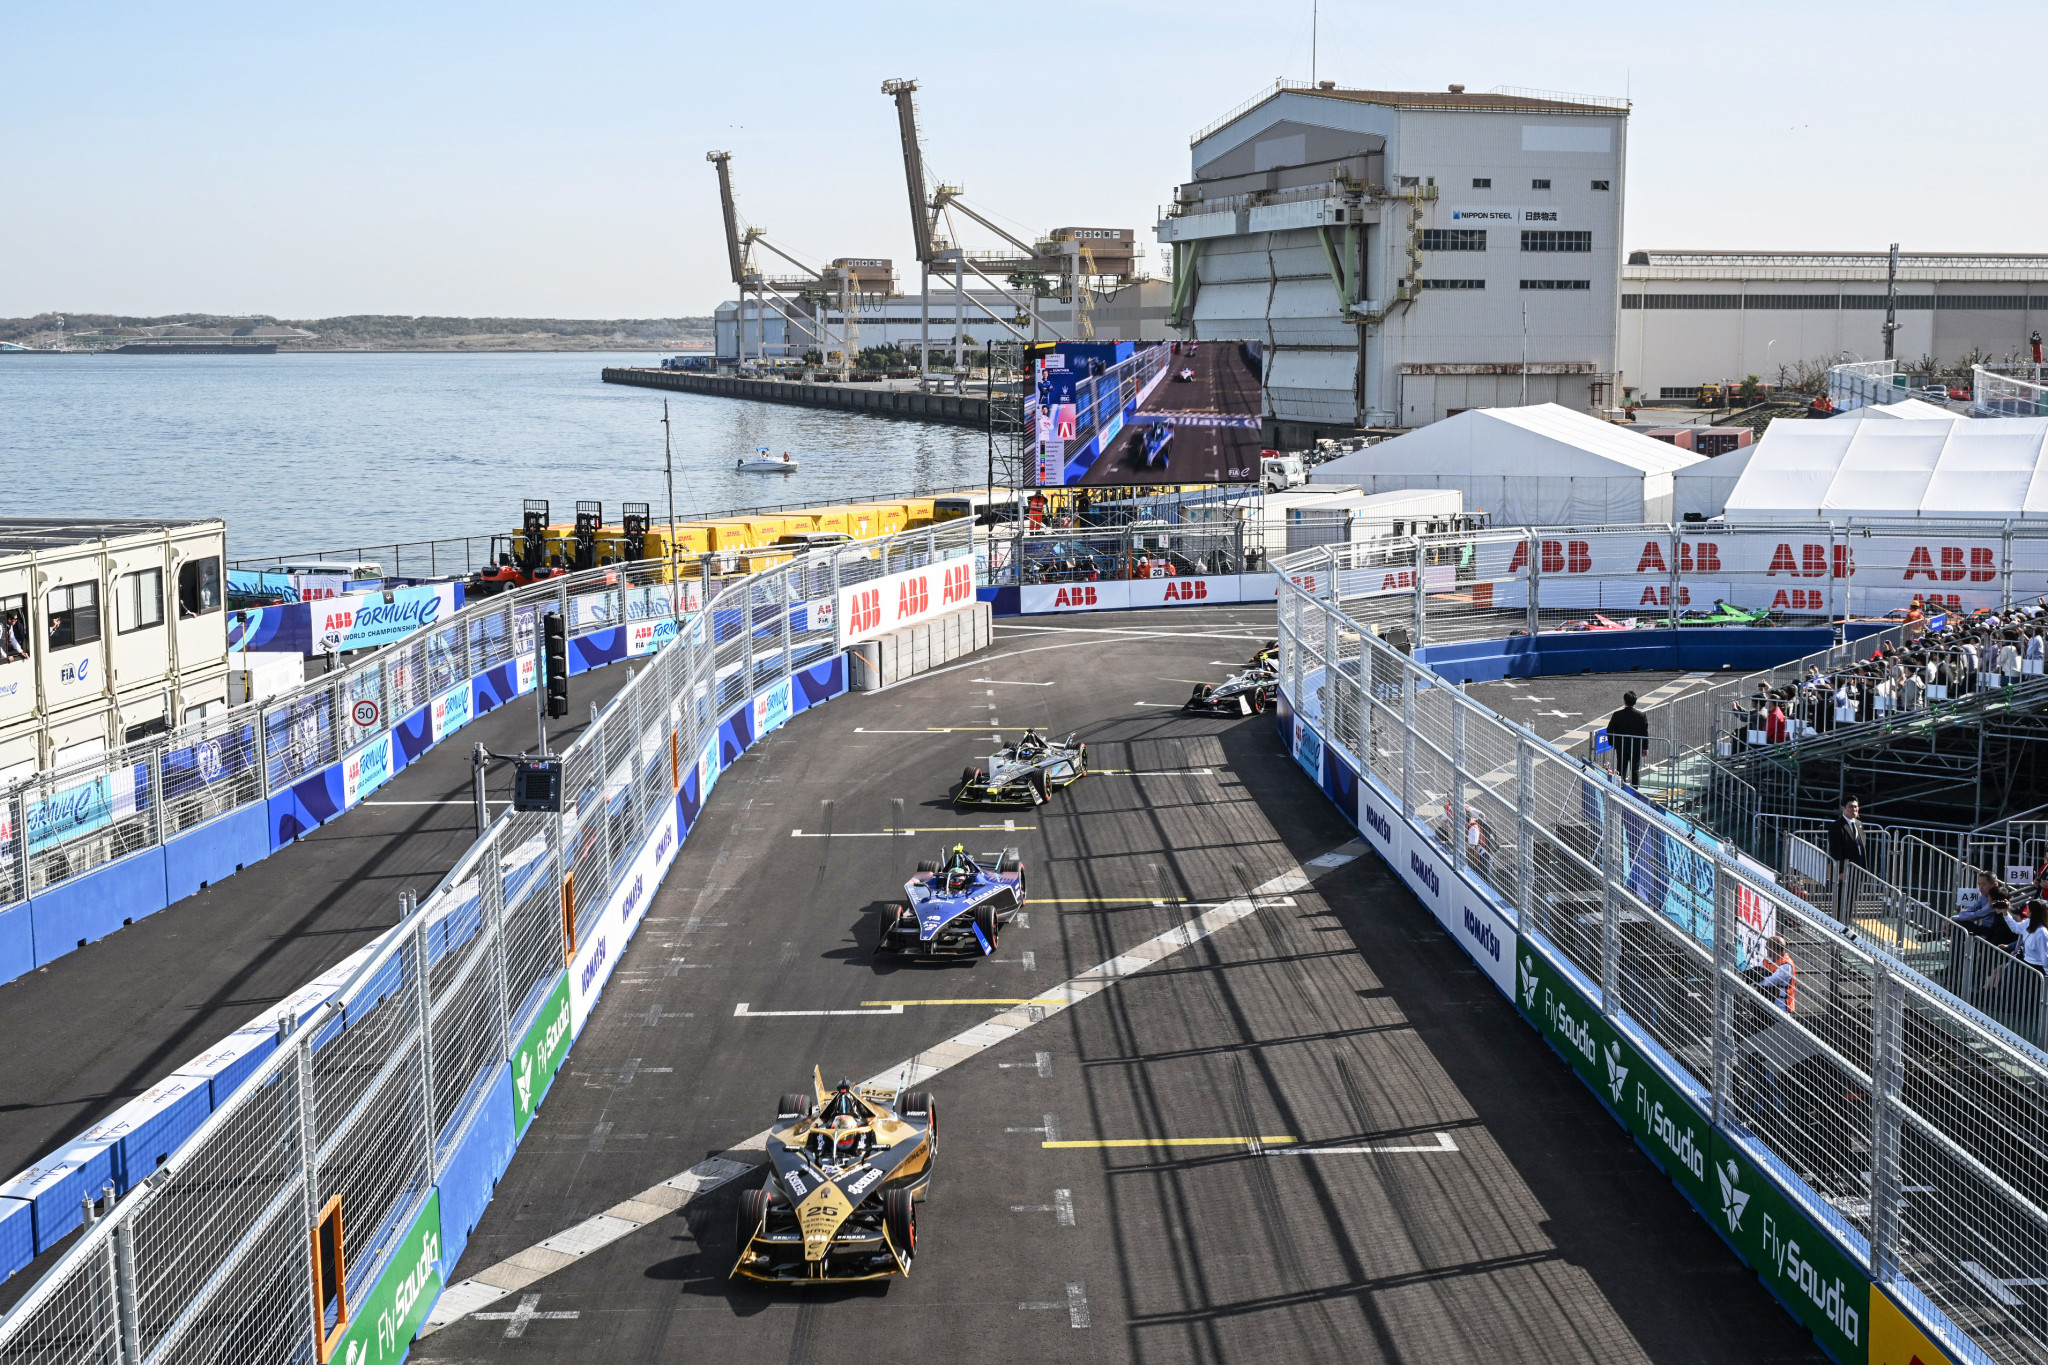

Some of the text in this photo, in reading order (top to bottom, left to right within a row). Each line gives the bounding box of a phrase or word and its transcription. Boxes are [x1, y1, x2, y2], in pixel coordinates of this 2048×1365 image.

[1489, 212, 1513, 220] STEEL
[1525, 211, 1558, 222] 日鉄物流
[1163, 418, 1239, 427] Allianz
[1508, 540, 1593, 573] ABB
[1636, 541, 1721, 575] ABB
[1766, 543, 1856, 578] ABB
[1903, 546, 1997, 582] ABB
[898, 575, 929, 620] ABB
[943, 564, 971, 606] ABB
[1054, 586, 1098, 607] ABB
[1164, 580, 1208, 601] ABB
[1640, 586, 1691, 606] ABB
[1771, 589, 1823, 609] ABB
[325, 612, 353, 631] ABB
[354, 600, 419, 629] FORMULA
[849, 588, 881, 636] ABB
[342, 632, 366, 641] WORLD
[367, 624, 417, 637] CHAMPIONSHIP
[635, 623, 679, 639] ABB FORM
[357, 708, 374, 720] 50
[349, 762, 360, 782] ABB
[360, 745, 381, 774] FORMULA
[1366, 804, 1391, 844] KOMATSU
[655, 824, 672, 867] KOMATSU
[1411, 850, 1440, 897] KOMATSU
[622, 873, 643, 924] KOMATSU
[1464, 906, 1500, 962] KOMATSU
[581, 935, 606, 996] KOMATSU
[537, 997, 569, 1075] FlySaudia
[1545, 988, 1595, 1066] FlySaudia
[1637, 1081, 1703, 1182] FlySaudia
[806, 1206, 838, 1217] 25
[378, 1230, 438, 1360] FlySaudia
[1763, 1212, 1858, 1346] FlySaudia
